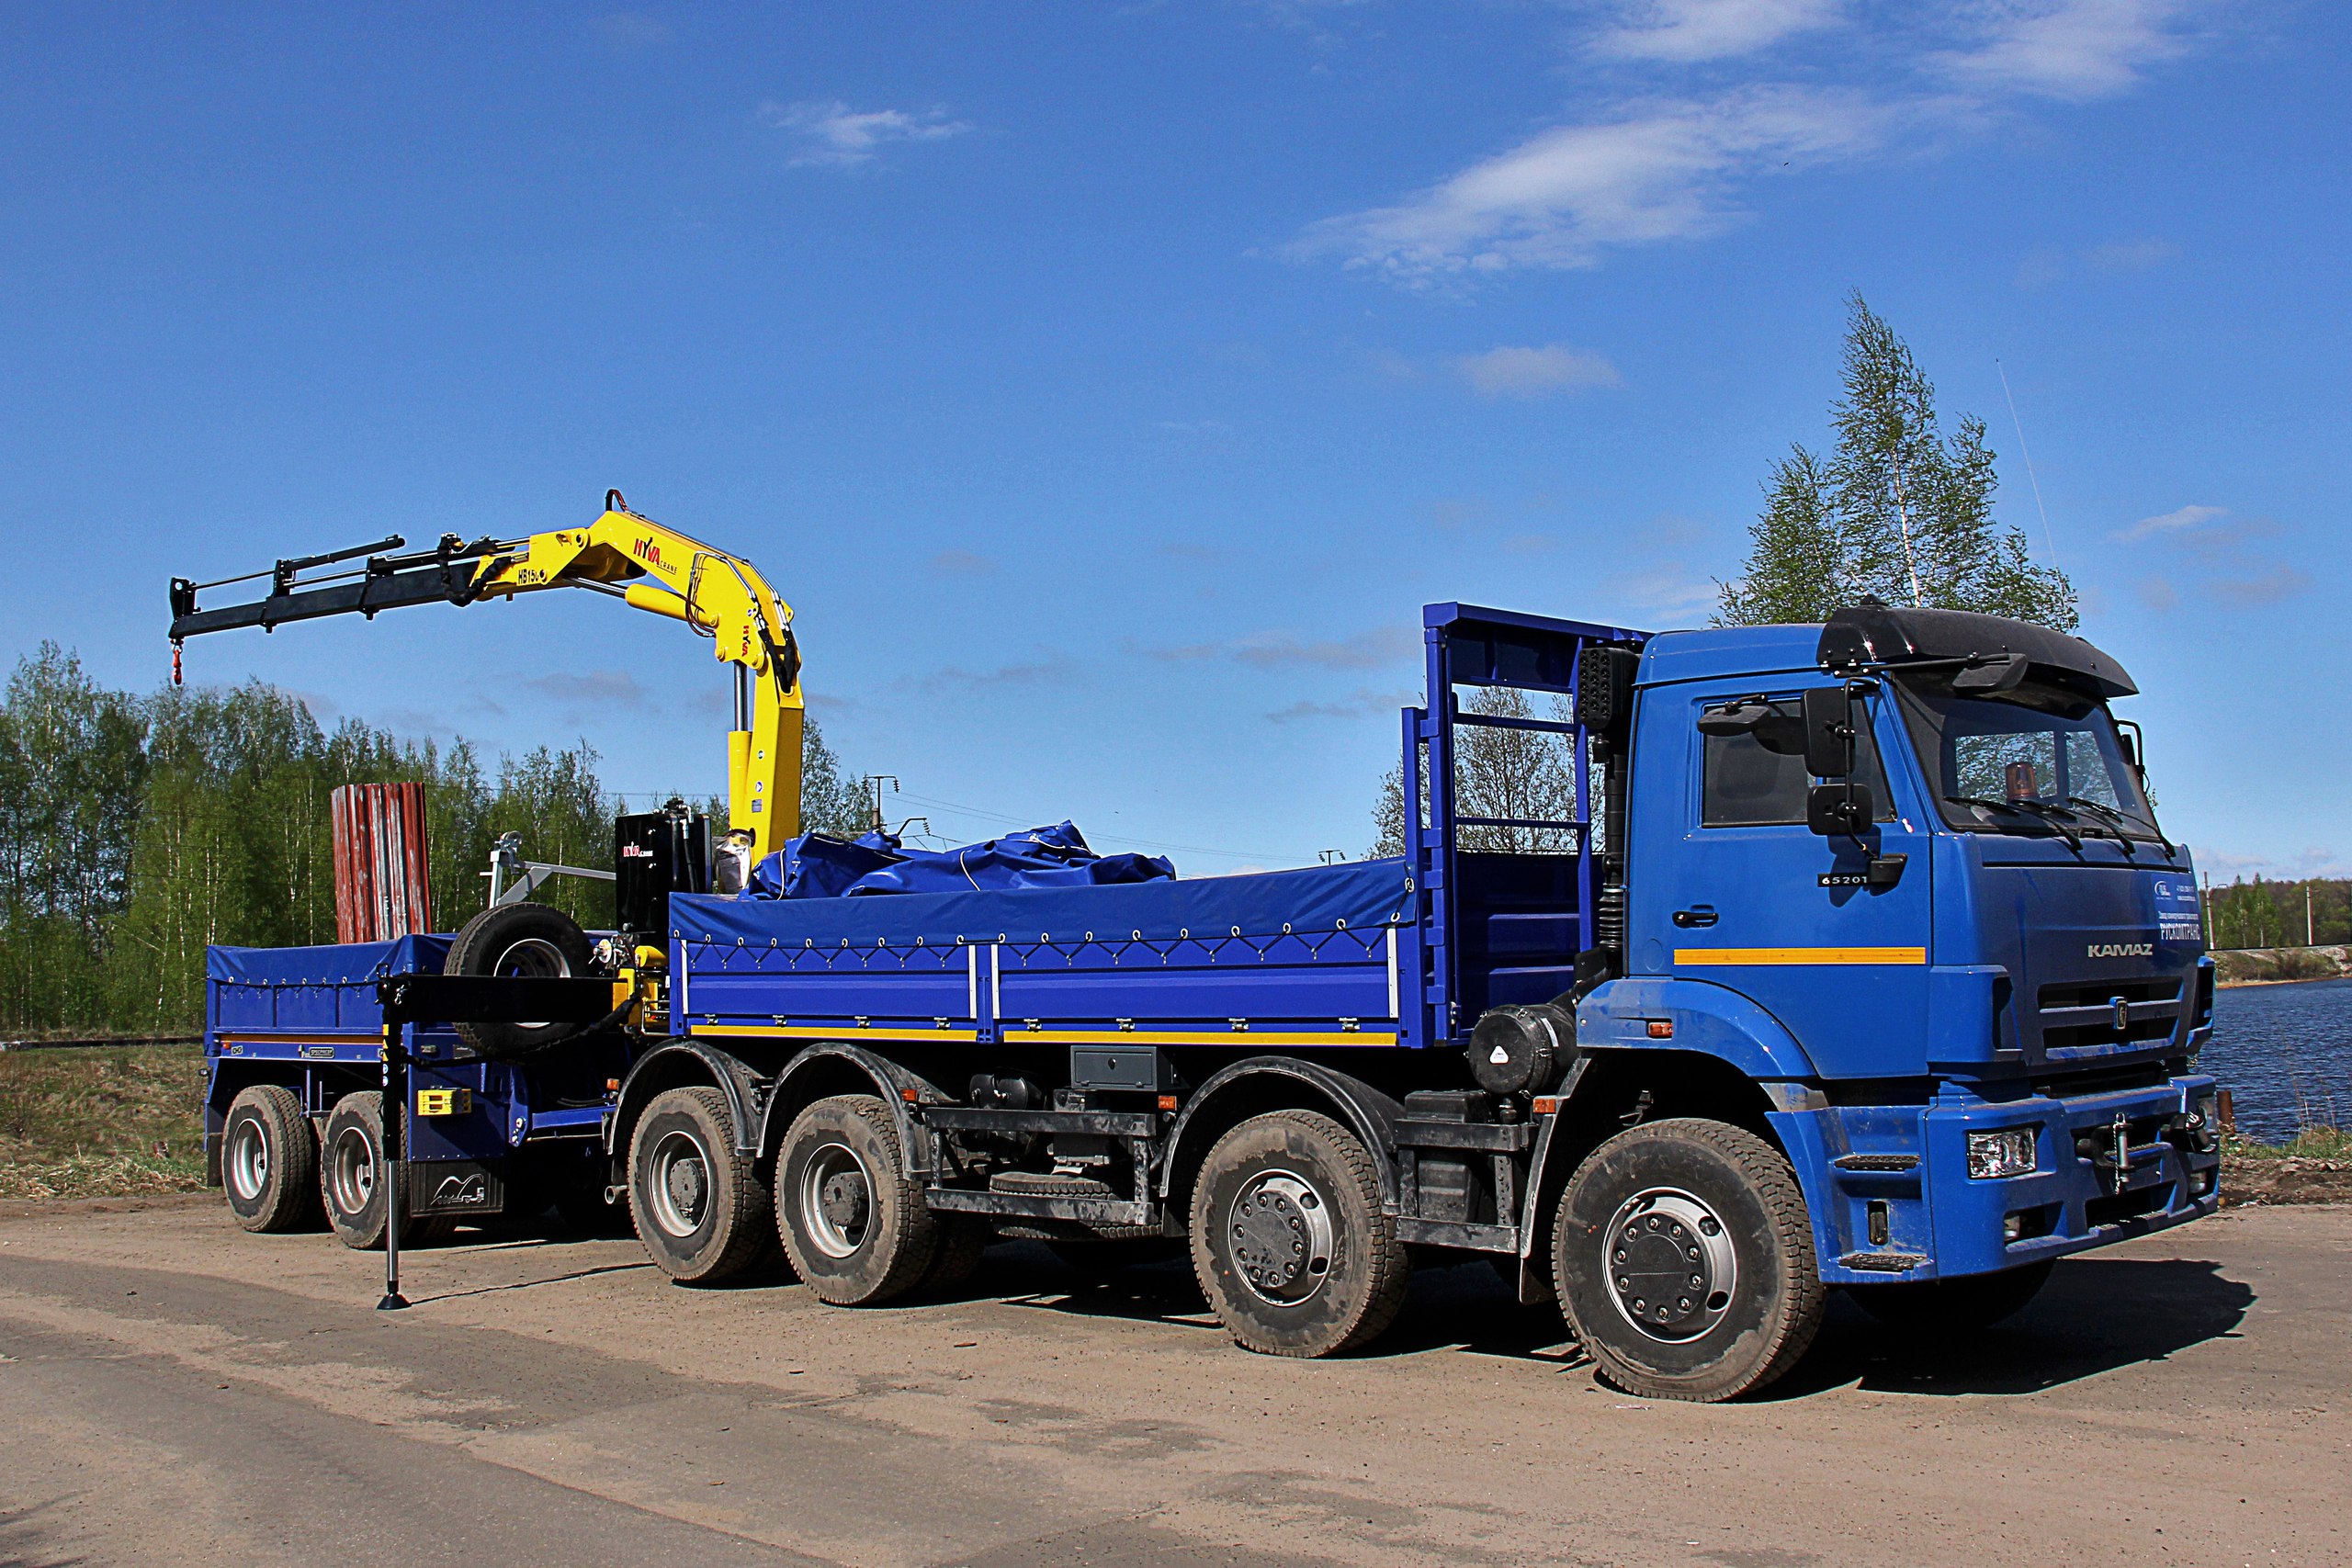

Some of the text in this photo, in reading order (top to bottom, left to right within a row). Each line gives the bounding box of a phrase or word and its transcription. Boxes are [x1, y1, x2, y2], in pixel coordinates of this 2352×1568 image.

[633, 536, 677, 574] HYVA CRANE
[741, 625, 752, 657] HYVA
[623, 840, 640, 858] HYVA
[1821, 875, 1868, 885] 65201
[2159, 922, 2200, 941] РУСКОМТРАНС
[2087, 943, 2154, 958] KAMAZ
